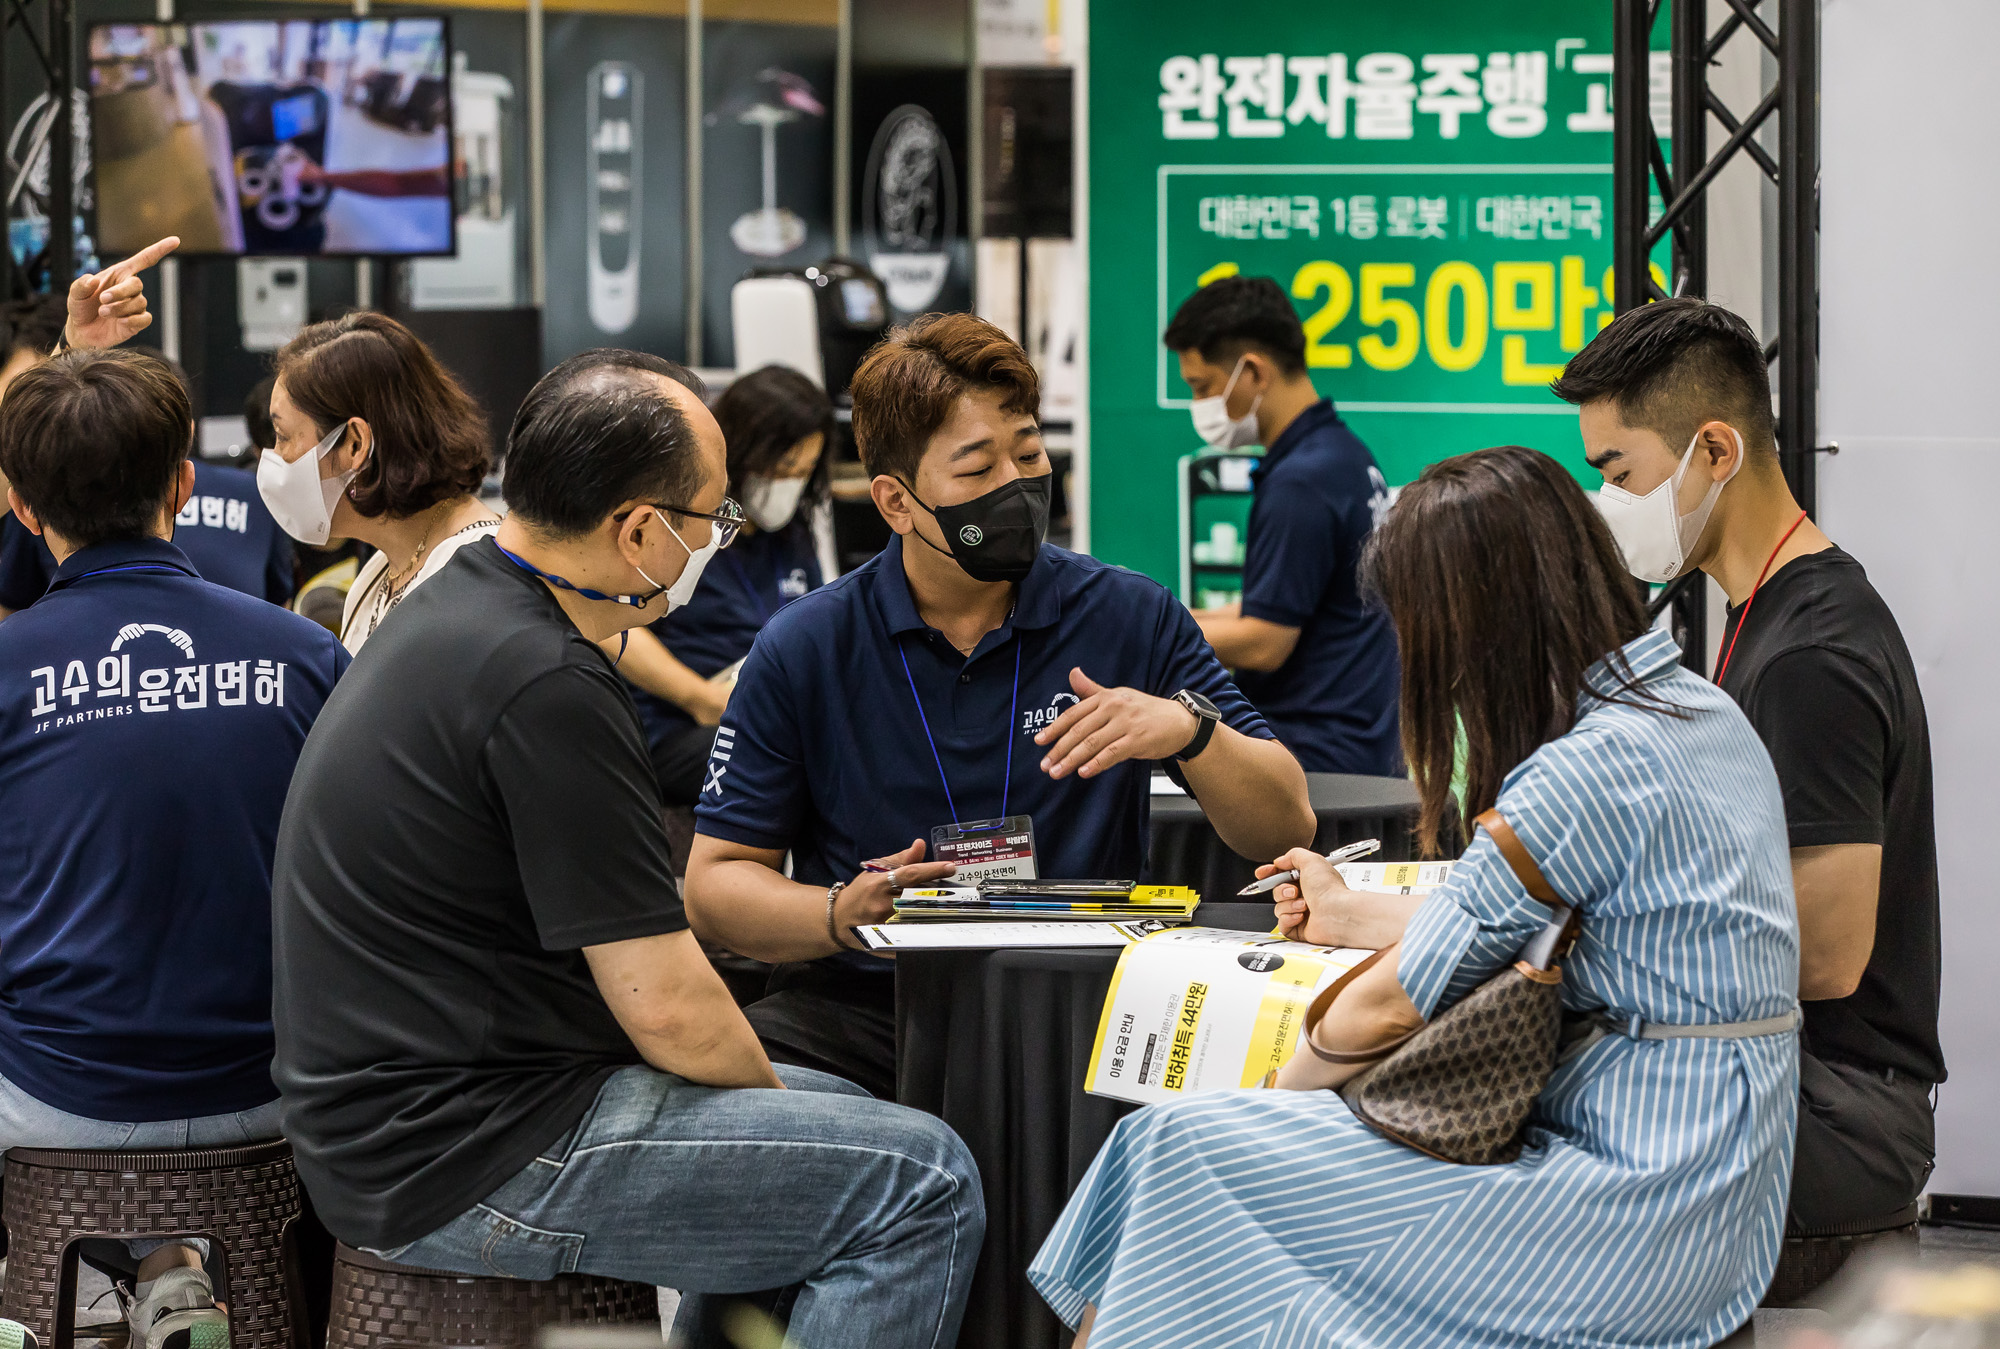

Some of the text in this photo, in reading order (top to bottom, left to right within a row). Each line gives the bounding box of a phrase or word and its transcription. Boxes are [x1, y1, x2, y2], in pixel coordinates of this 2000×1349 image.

[1158, 50, 1549, 140] 완전자율주행
[1199, 195, 1320, 240] 대한민국
[1328, 195, 1379, 240] 1등
[1386, 195, 1448, 240] 로봇
[1475, 195, 1602, 240] 대한민국
[34, 704, 133, 734] JF PARTNERS
[1023, 706, 1059, 729] 고수의
[1109, 1013, 1135, 1078] 이용 요금 안내
[1164, 1029, 1194, 1090] 면허취득
[1181, 981, 1209, 1028] 44만원
